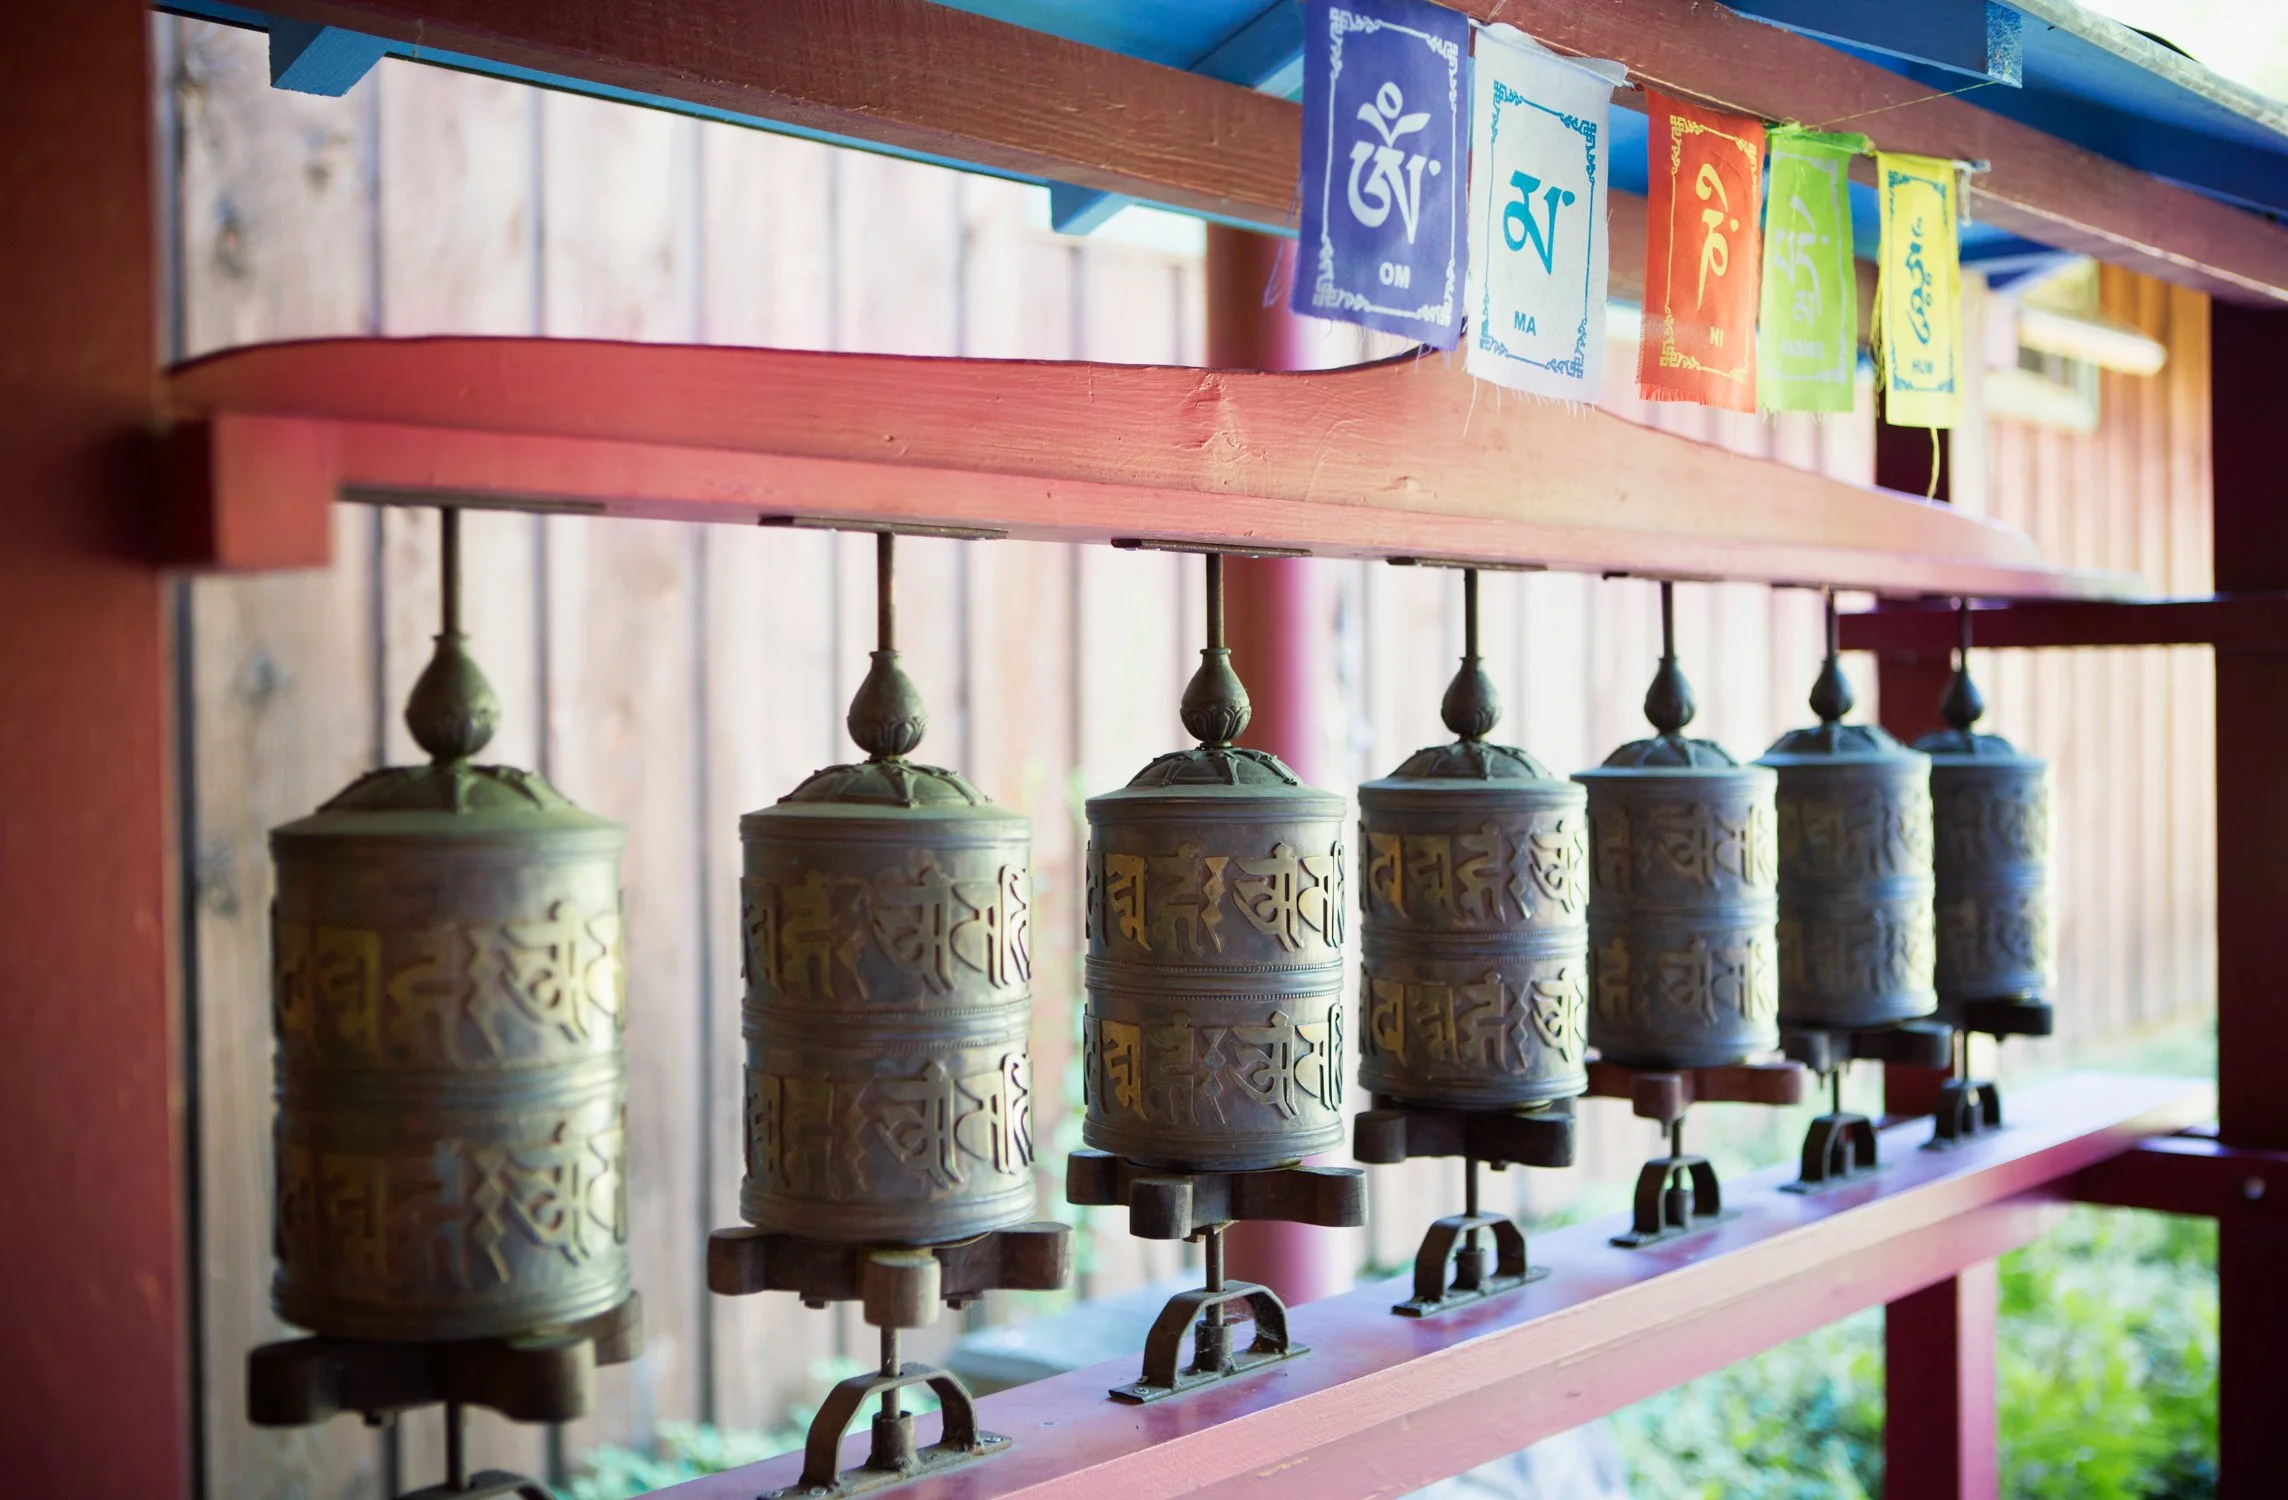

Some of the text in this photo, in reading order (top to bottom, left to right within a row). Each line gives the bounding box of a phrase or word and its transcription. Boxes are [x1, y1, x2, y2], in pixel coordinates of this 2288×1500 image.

[1379, 262, 1410, 288] OM
[1513, 311, 1536, 336] MA
[1709, 326, 1725, 348] NI
